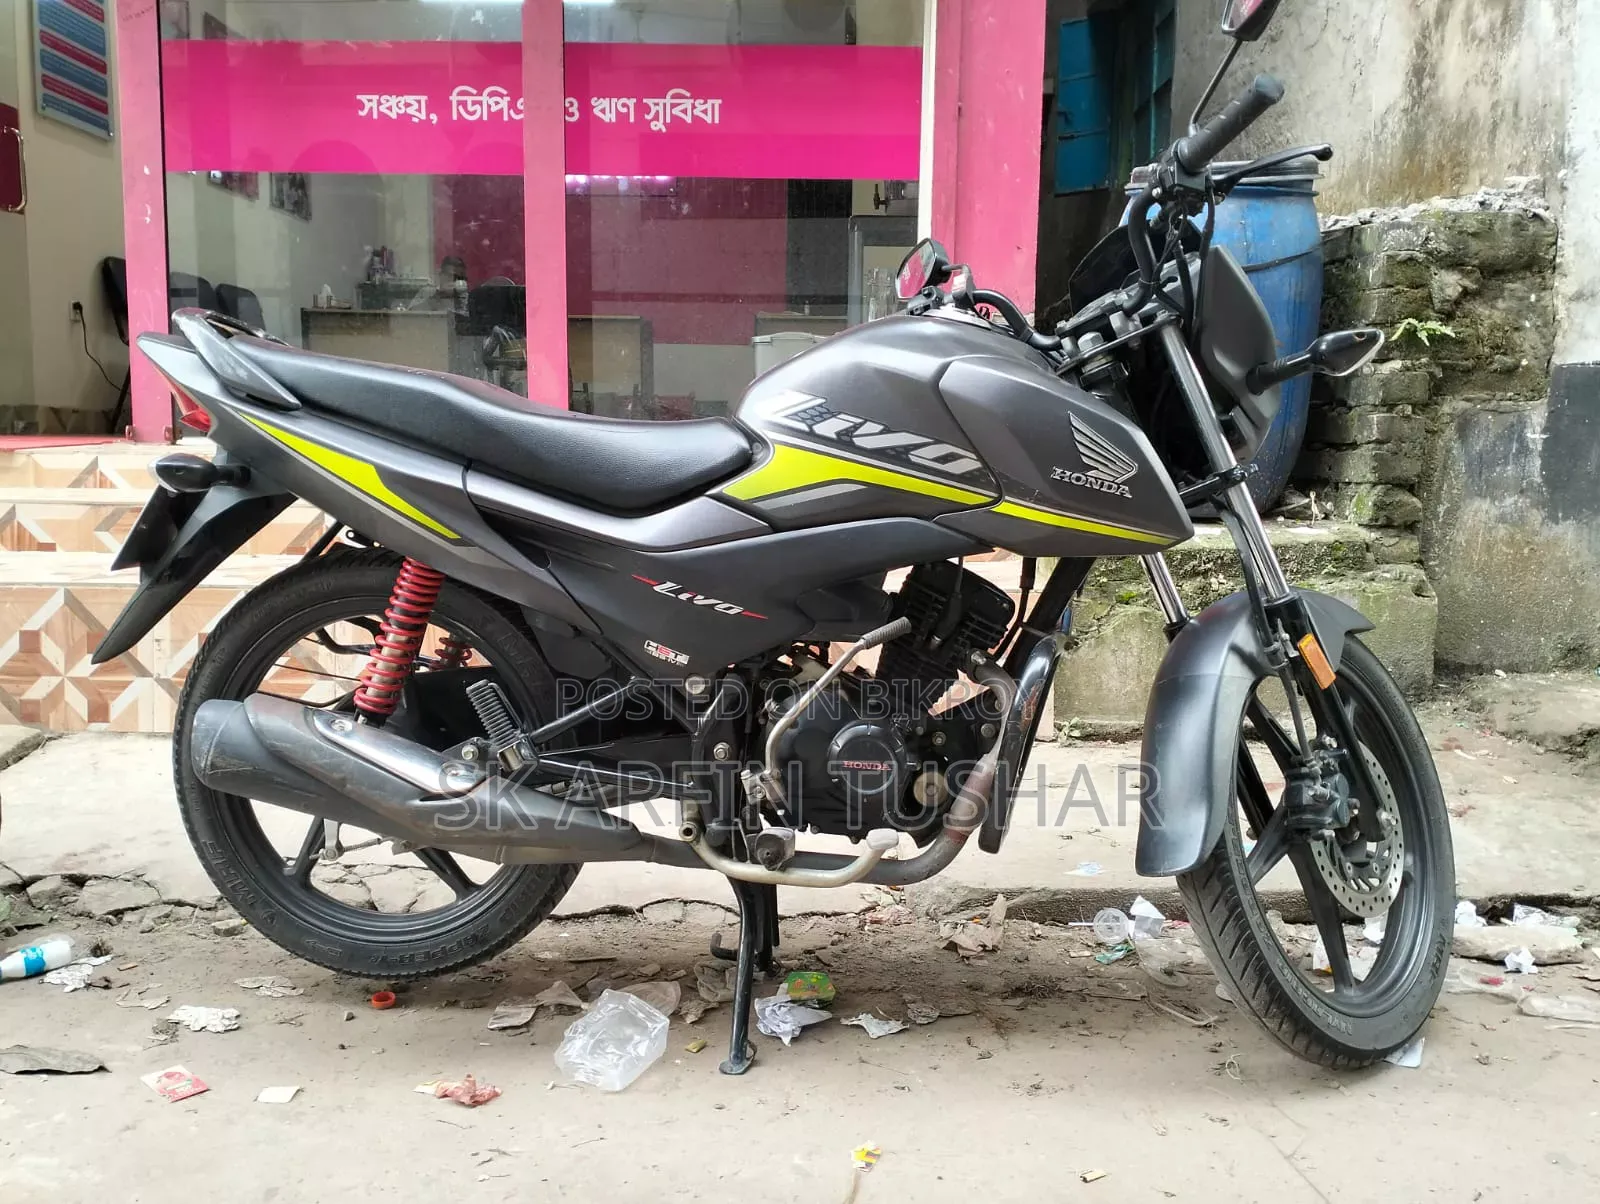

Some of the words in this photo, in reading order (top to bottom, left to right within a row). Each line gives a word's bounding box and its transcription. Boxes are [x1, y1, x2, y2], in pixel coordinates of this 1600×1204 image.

[356, 94, 438, 124] সঞ্চয়,
[591, 96, 637, 123] ঋণ
[643, 88, 722, 132] সুবিধা
[1050, 466, 1133, 498] HONDA
[842, 760, 892, 771] HONDA
